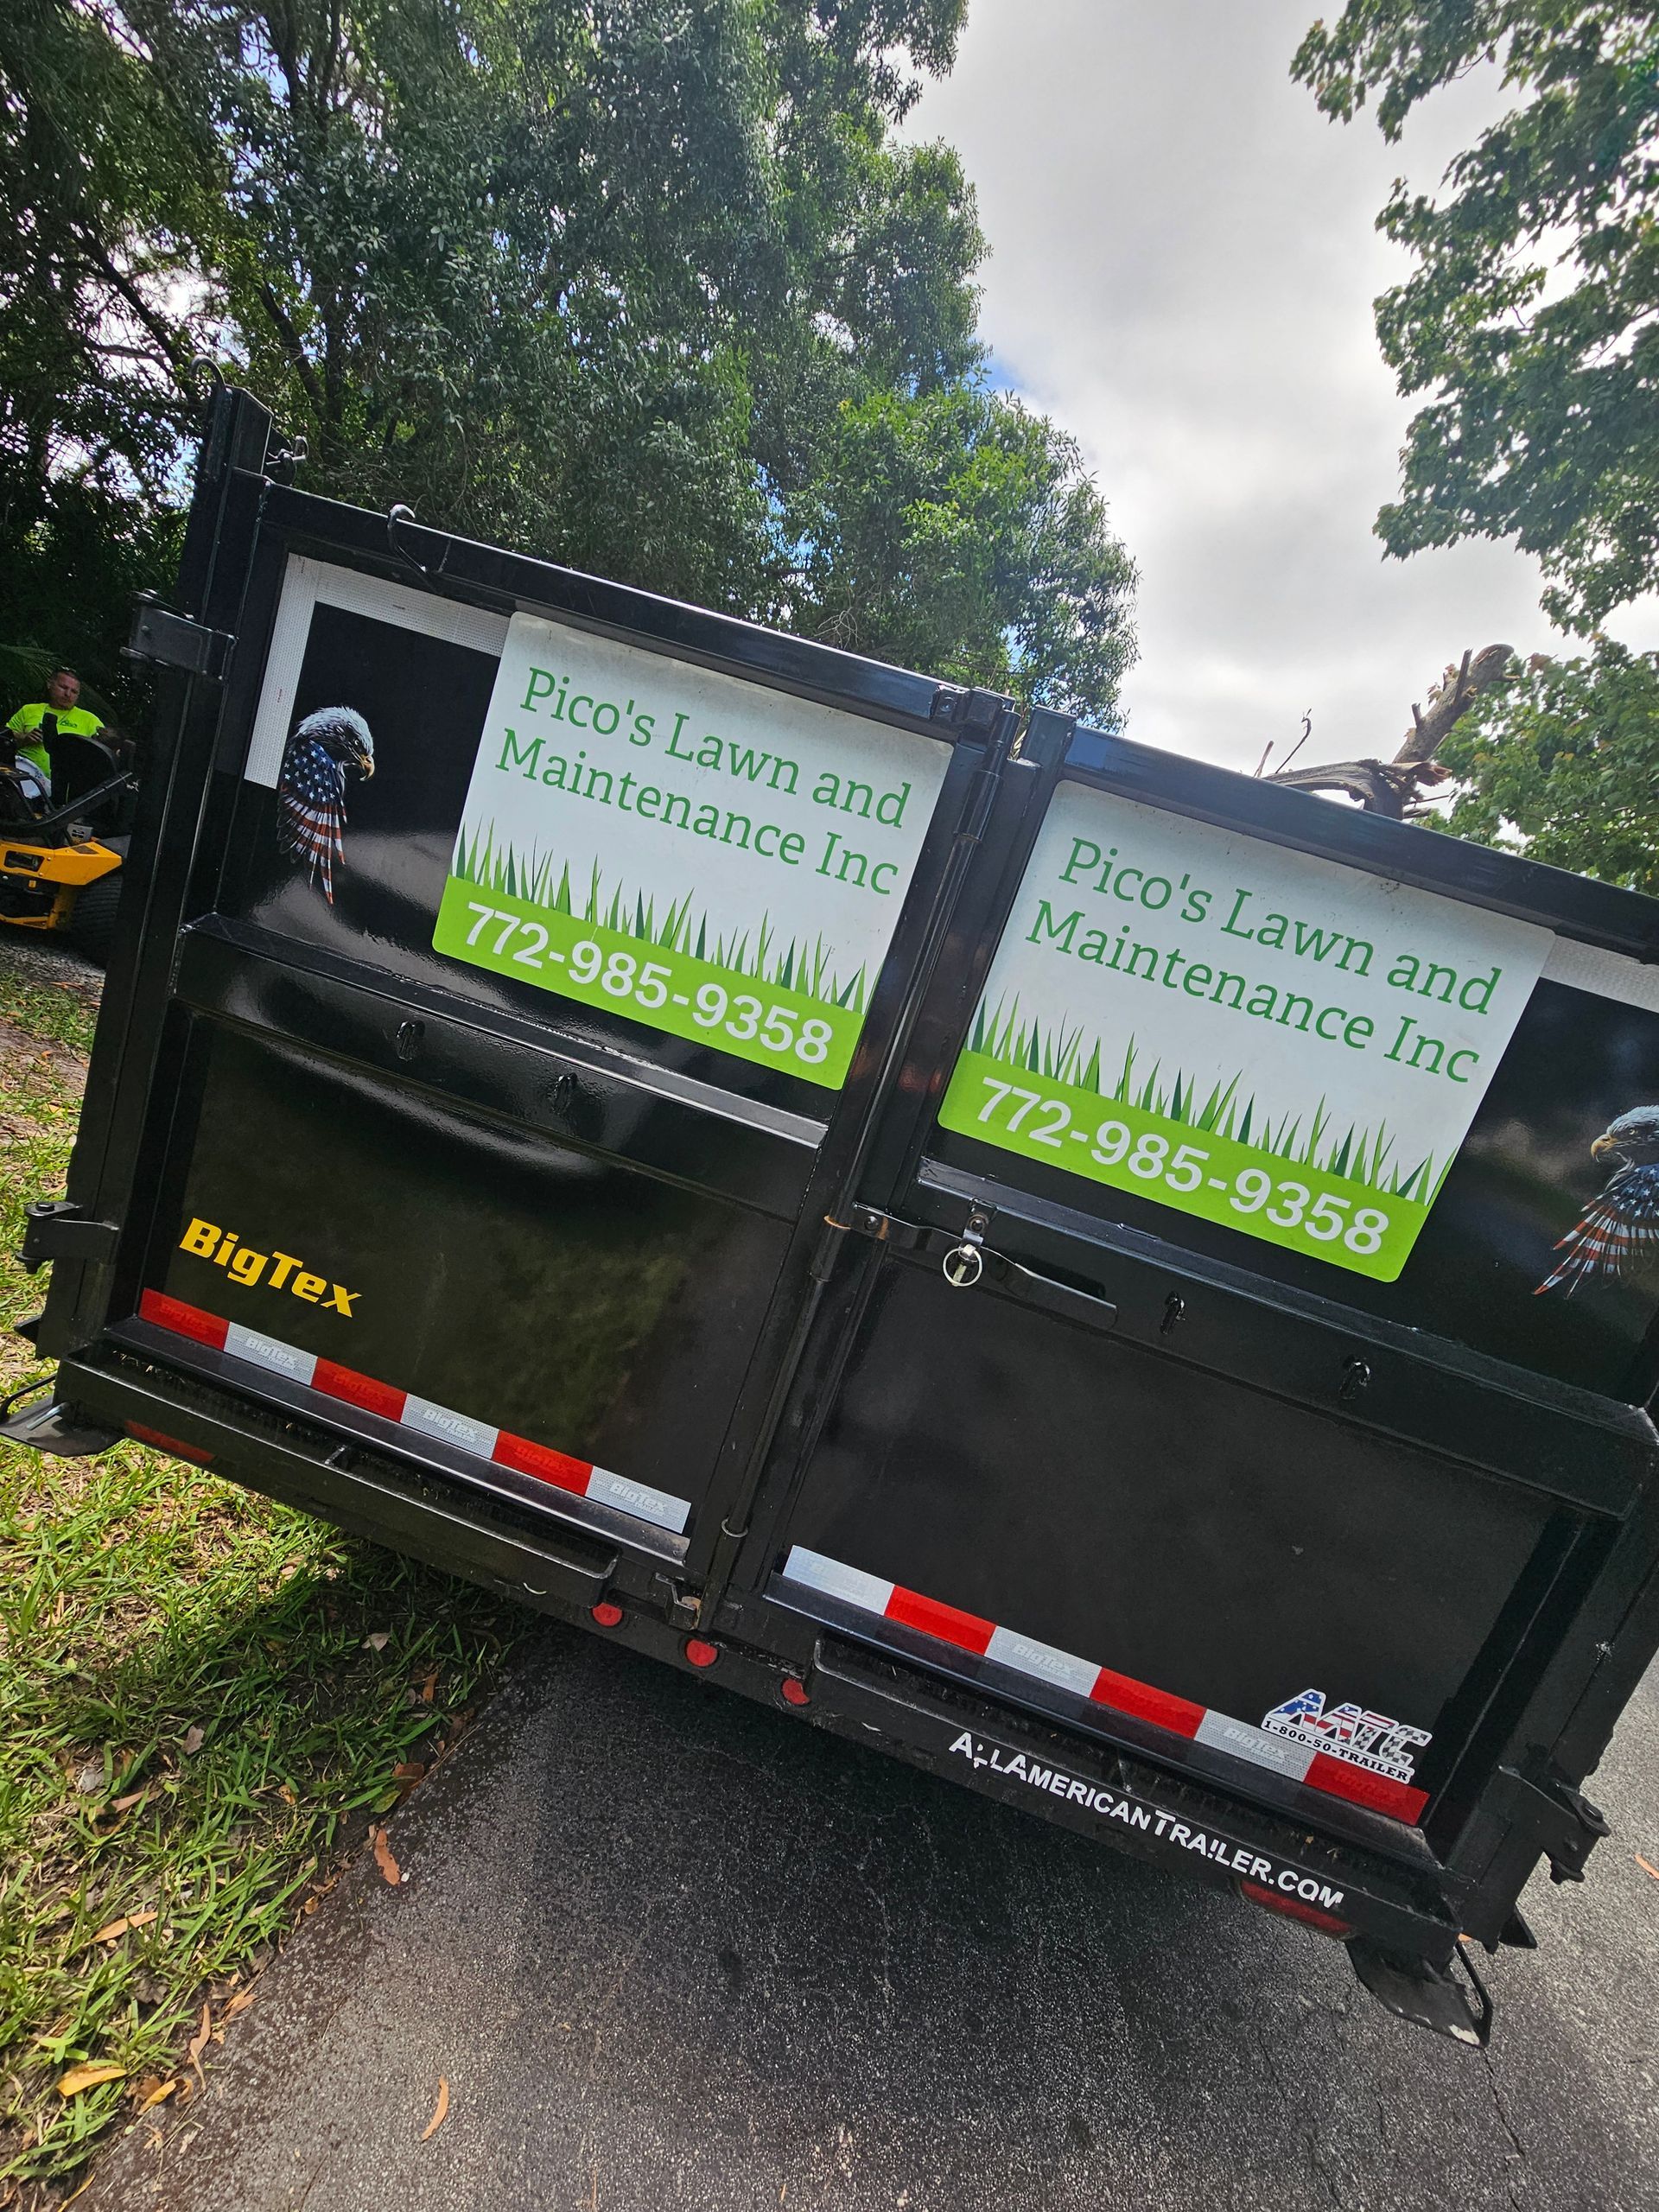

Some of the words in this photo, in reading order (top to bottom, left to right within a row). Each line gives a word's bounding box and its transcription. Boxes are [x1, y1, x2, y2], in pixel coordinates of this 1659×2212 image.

[519, 665, 656, 747] Pico's
[664, 712, 800, 795] Lawn
[811, 772, 912, 830] and
[494, 728, 806, 866] Maintenance
[815, 831, 900, 896] Inc
[1058, 837, 1213, 924] Pico's
[1220, 889, 1375, 977] Lawn
[1386, 953, 1503, 1016] and
[467, 901, 834, 1065] 772-985-9358
[1025, 899, 1375, 1050] Maintenance
[1383, 1016, 1481, 1084] Inc
[976, 1076, 1390, 1255] 772-985-9358
[178, 1217, 363, 1319] BigTex
[245, 1337, 297, 1367] BigTex
[423, 1408, 479, 1438] BigTex
[610, 1483, 668, 1512] BigTex
[1012, 1643, 1076, 1675] BigTex
[1222, 1729, 1288, 1760] BigTex
[1263, 1719, 1410, 1783] 1-800-50-TRAILER
